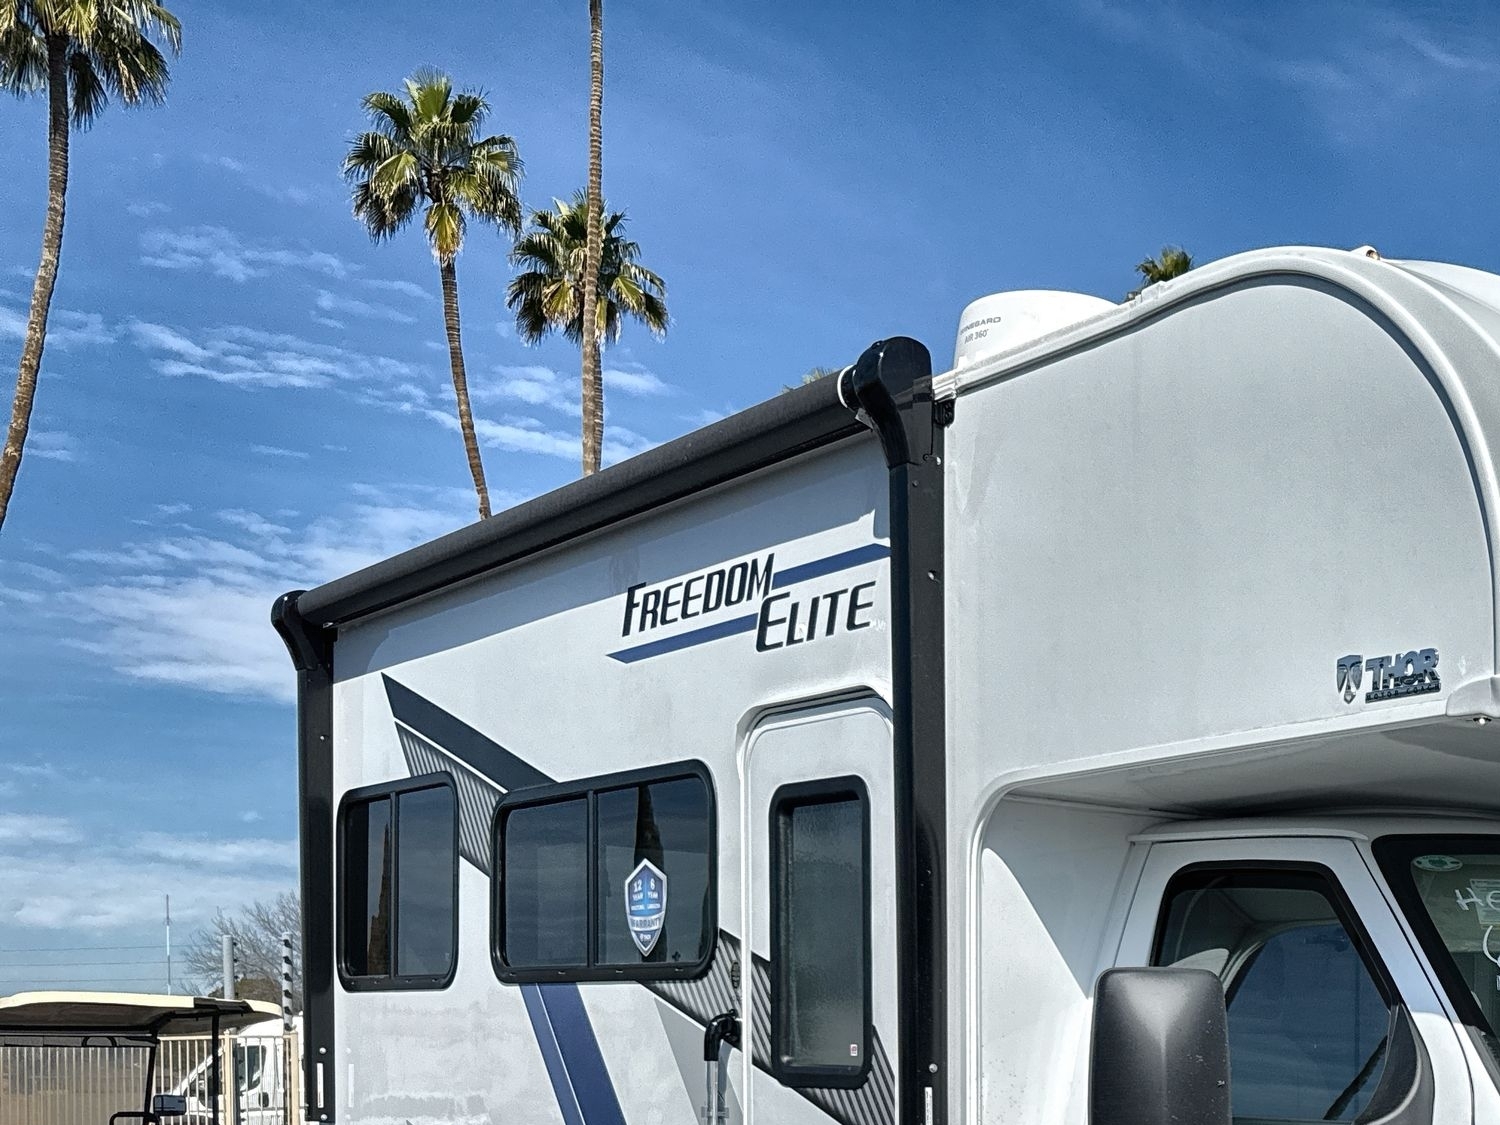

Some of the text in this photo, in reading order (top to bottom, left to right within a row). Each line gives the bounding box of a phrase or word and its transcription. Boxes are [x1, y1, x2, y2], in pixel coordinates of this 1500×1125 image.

[622, 553, 775, 637] FREEDOM
[756, 581, 876, 652] ELITE
[1365, 648, 1440, 691] THOR
[1366, 689, 1399, 701] MOTOR
